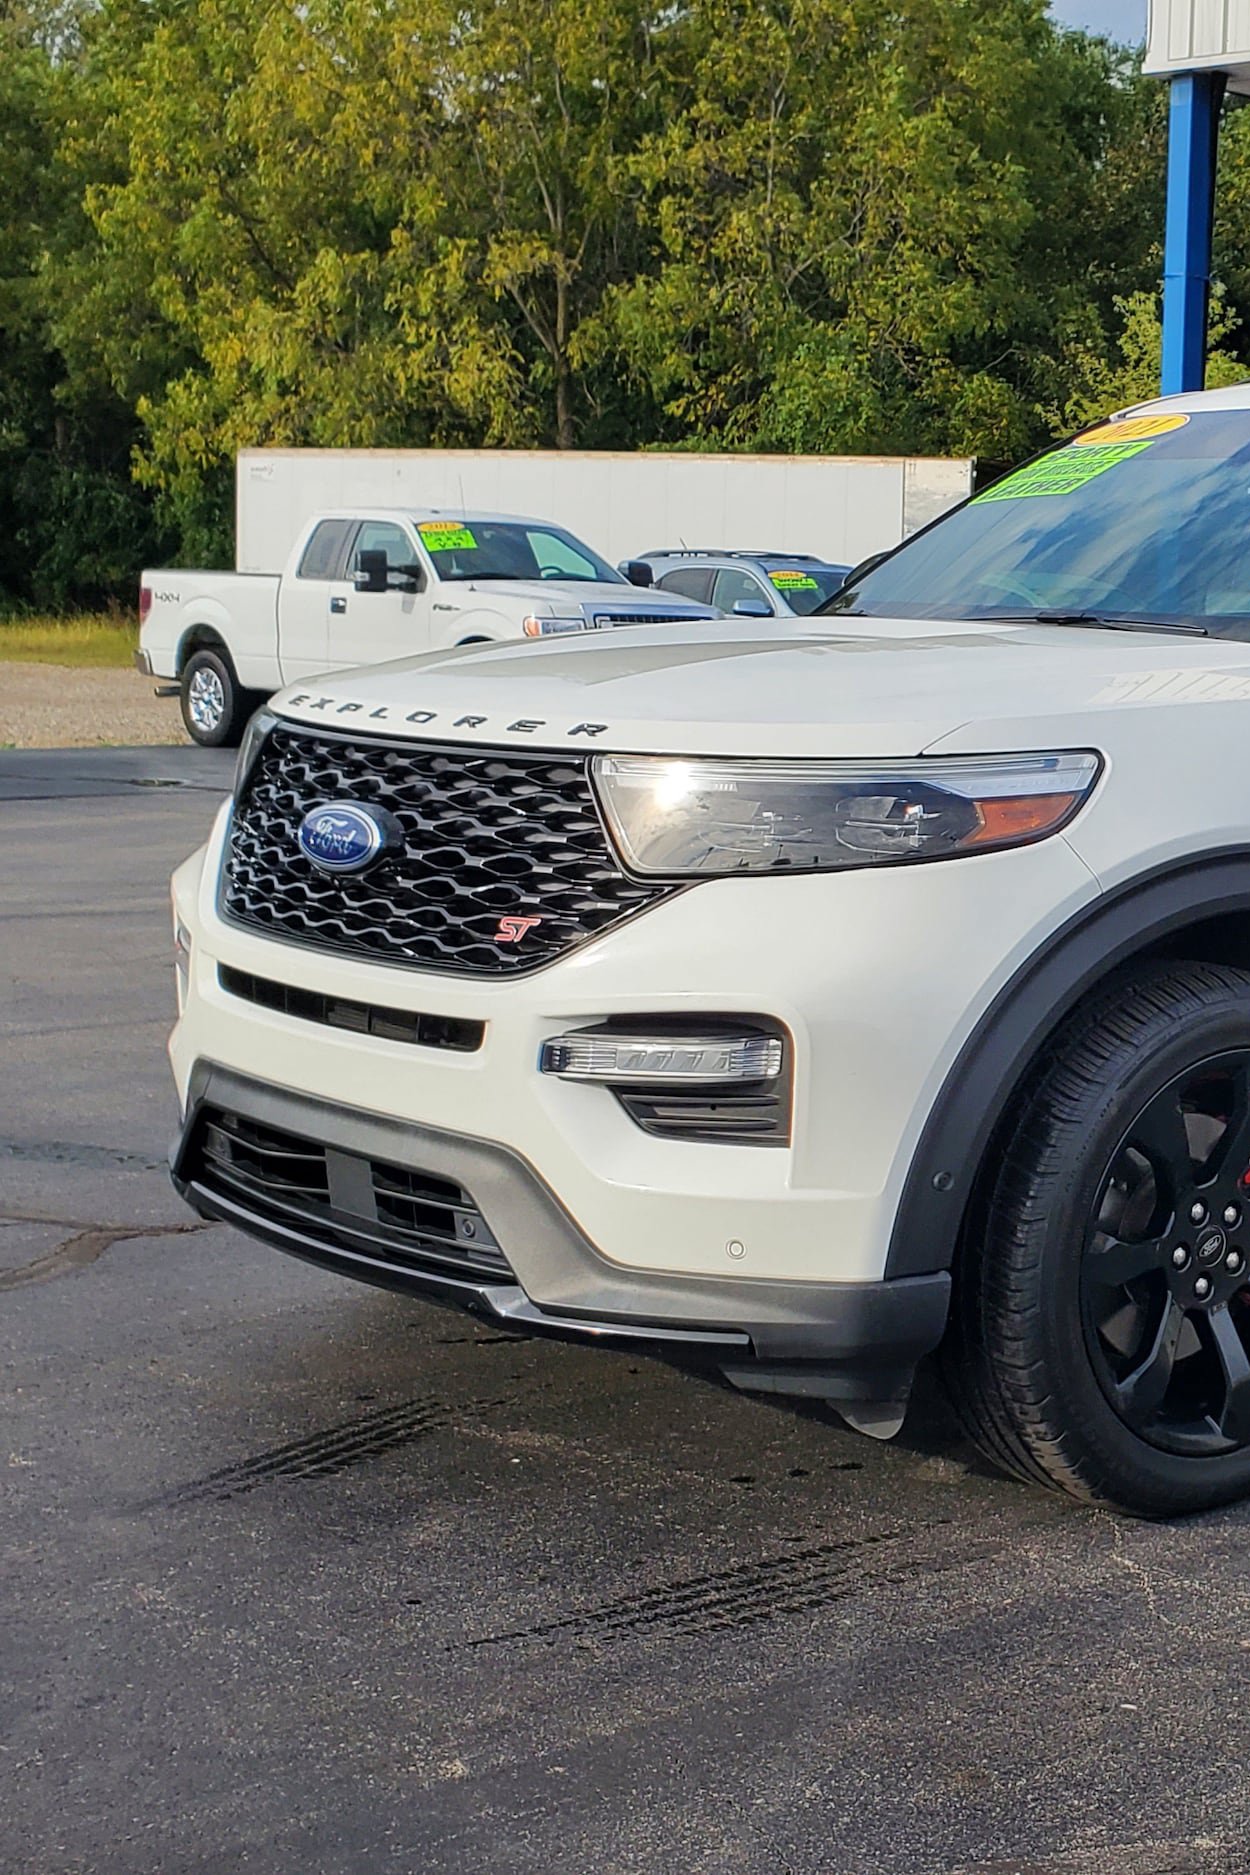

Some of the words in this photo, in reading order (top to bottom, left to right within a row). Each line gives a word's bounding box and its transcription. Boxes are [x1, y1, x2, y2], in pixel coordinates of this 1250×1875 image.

[288, 695, 609, 737] EXPLORER
[309, 815, 357, 857] Ford
[493, 916, 541, 943] ST
